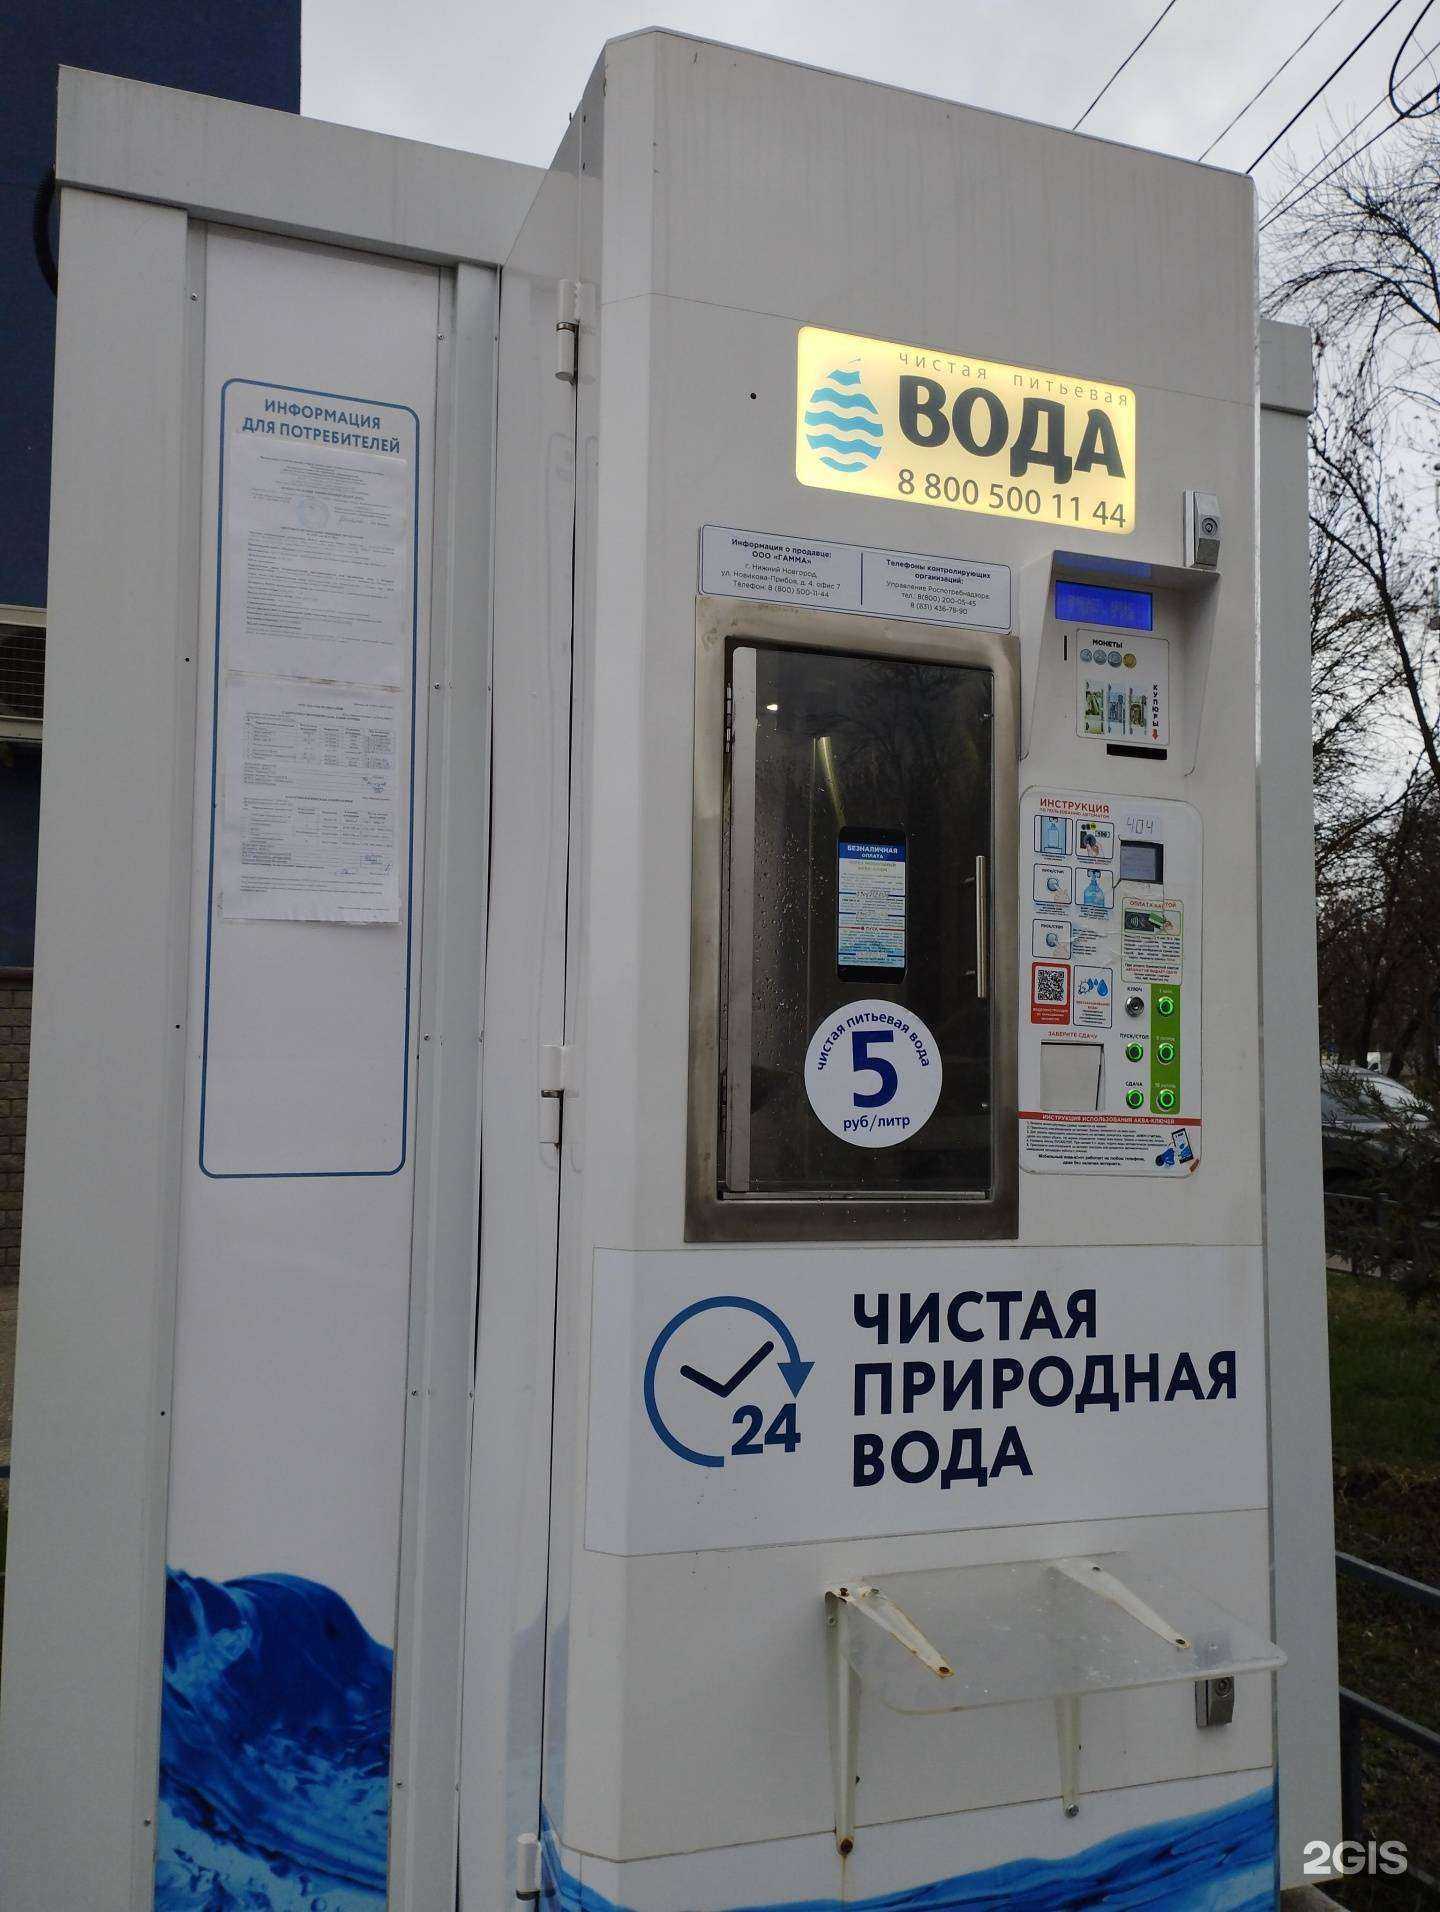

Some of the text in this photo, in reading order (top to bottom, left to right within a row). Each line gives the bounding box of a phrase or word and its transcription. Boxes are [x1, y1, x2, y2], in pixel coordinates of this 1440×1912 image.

[899, 352, 1128, 407] чистая питьевая
[264, 398, 381, 430] ИНФОРМАЦИЯ
[242, 416, 401, 454] ДЛЯ ПОТРЕБИТЕЛЕЙ
[898, 374, 1127, 485] ВОДА
[897, 468, 1126, 528] 8 800 500 11 44
[731, 538, 784, 552] Информация
[792, 548, 832, 559] продавце:
[752, 551, 812, 565] ООО «ГАММА»
[752, 564, 781, 574] Нижний
[886, 559, 991, 579] Телефоны контролирующих
[915, 572, 964, 585] организаций:
[733, 580, 769, 592] Телефон:
[774, 585, 795, 595] (800)
[796, 586, 830, 598] 500-11-44
[816, 581, 834, 590] офис
[886, 580, 927, 592] Управление
[1092, 638, 1123, 649] МОНЕТЫ
[1152, 684, 1160, 727] КУПЮРЫ
[1040, 798, 1110, 814] ИНСТРУКЦИЯ
[1126, 816, 1154, 834] 404
[847, 844, 898, 854] БЕЗНАЛИЧНАЯ
[817, 1012, 930, 1071] чистая питьевая вода
[851, 1029, 899, 1109] 5
[843, 1114, 911, 1132] руб/литр
[1042, 1113, 1081, 1122] ИНСТРУКЦИЯ
[853, 1288, 1097, 1345] ЧИСТАЯ
[853, 1350, 1238, 1417] ПРИРОДНАЯ
[731, 1403, 801, 1456] 24
[853, 1425, 1034, 1490] ВОДА
